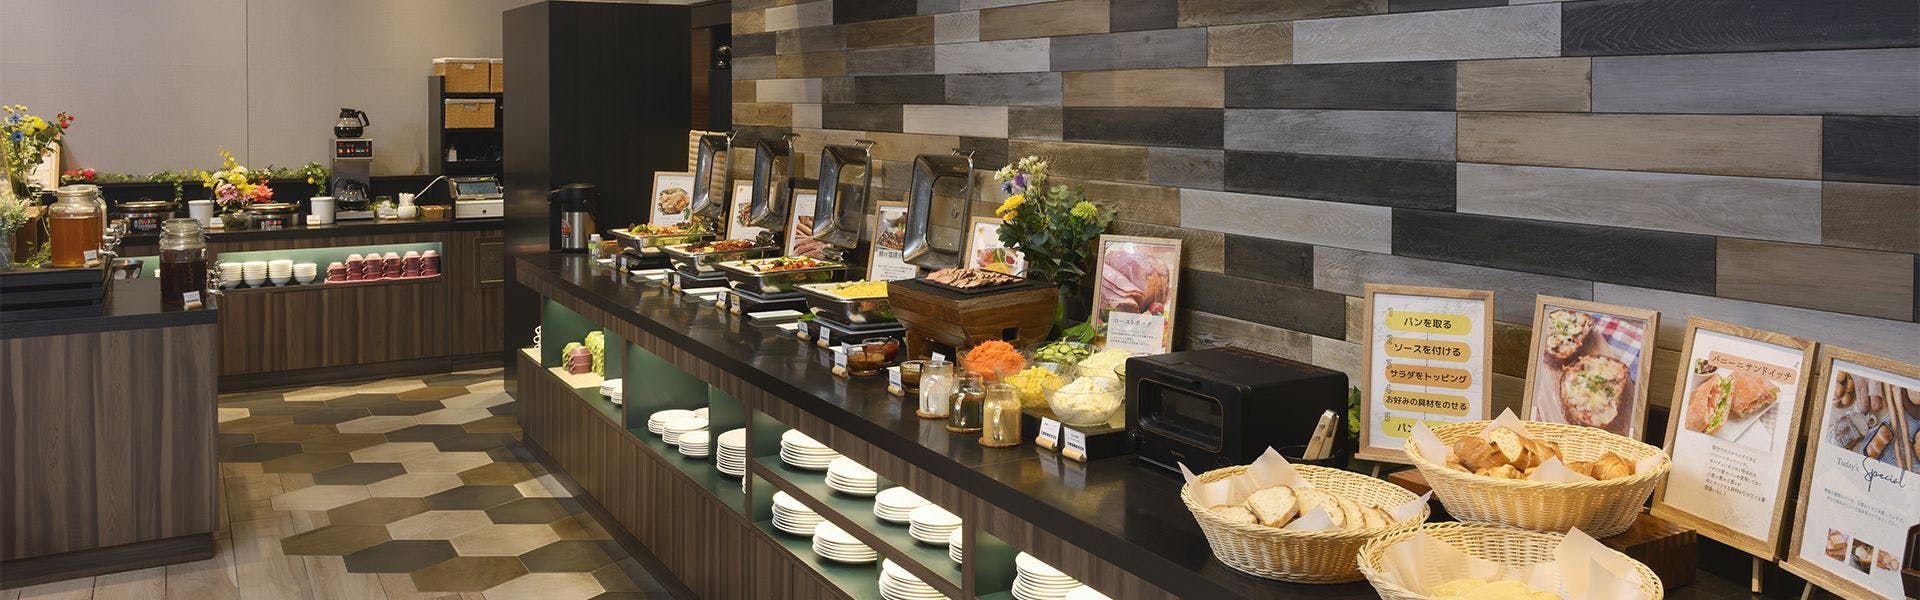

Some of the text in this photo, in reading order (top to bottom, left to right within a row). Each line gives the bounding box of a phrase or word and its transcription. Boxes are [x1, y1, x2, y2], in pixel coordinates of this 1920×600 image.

[1404, 317, 1452, 330] パンを取る
[1393, 343, 1462, 357] ソースを付ける
[1390, 369, 1468, 384] サラダをトッピング
[1385, 395, 1468, 411] お好みの具材をのせる
[1836, 456, 1906, 492] Today's Special
